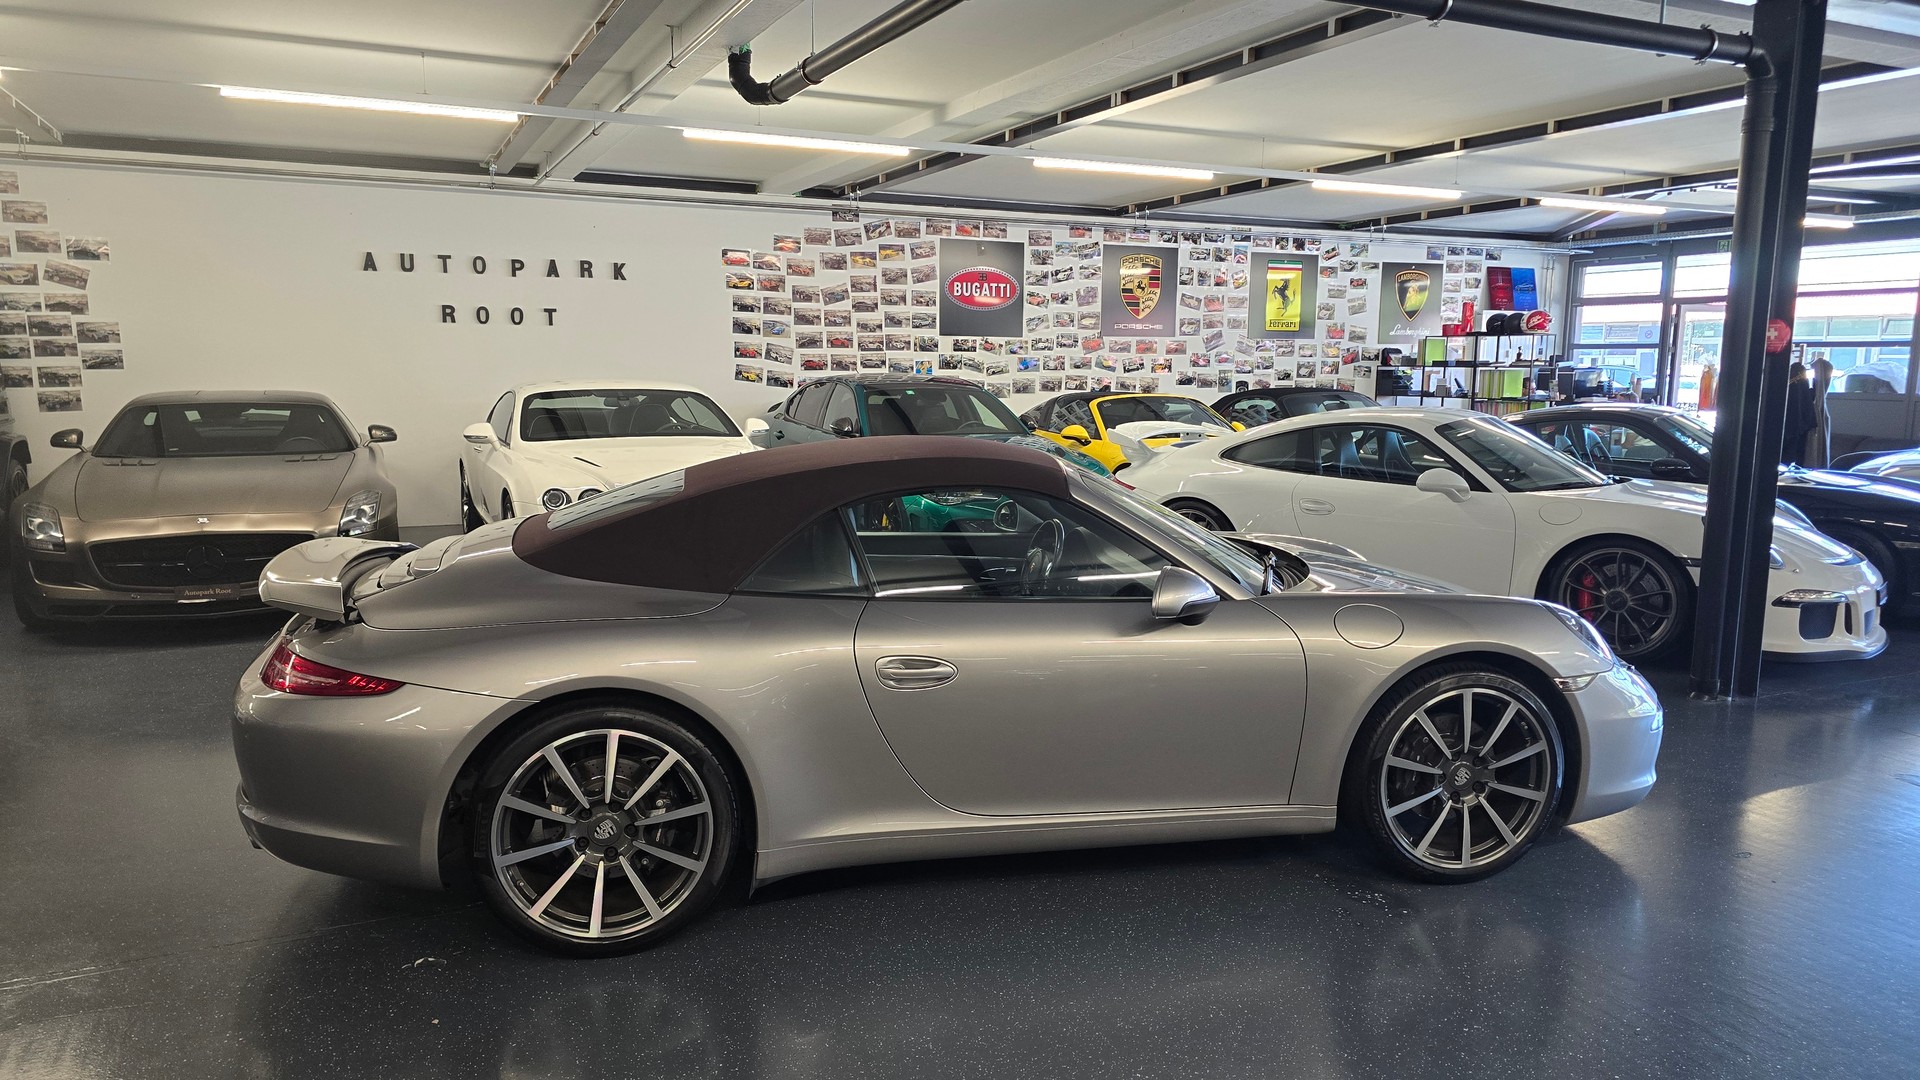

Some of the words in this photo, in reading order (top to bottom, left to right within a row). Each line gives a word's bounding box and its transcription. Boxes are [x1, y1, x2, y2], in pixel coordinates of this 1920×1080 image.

[362, 251, 627, 281] AUTOPARK
[1122, 256, 1161, 266] PORSCHE
[953, 281, 1011, 298] BUGATTI
[440, 304, 558, 327] ROOT
[1268, 319, 1297, 329] Ferrari
[1389, 324, 1431, 337] Lamborghini
[184, 589, 214, 597] Autopark
